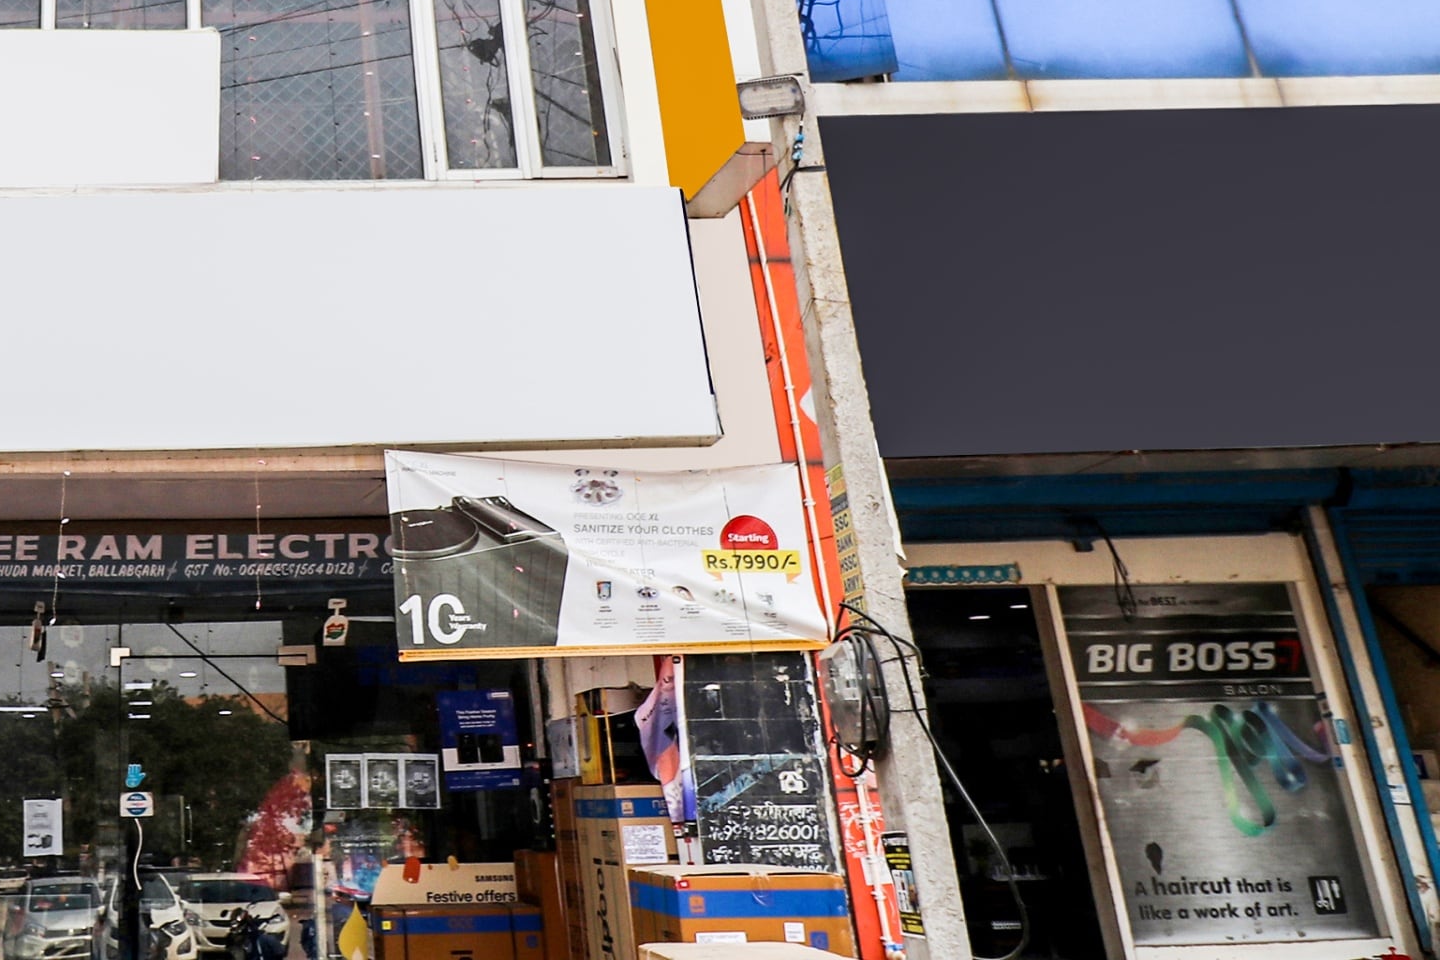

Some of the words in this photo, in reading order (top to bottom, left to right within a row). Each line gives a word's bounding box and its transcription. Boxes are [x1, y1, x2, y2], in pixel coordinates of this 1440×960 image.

[573, 524, 624, 534] SANITIZE
[627, 525, 659, 535] YOUR
[661, 525, 714, 536] CLOTHES
[727, 532, 770, 545] Starting
[57, 535, 163, 561] RAM
[32, 564, 86, 580] MARKET,
[88, 563, 165, 578] BALLABGARH
[184, 563, 209, 577] GST
[448, 613, 471, 622] Years
[1086, 643, 1153, 674] BIG
[1223, 684, 1282, 696] SALON
[475, 874, 514, 883] SAMSUNG
[1135, 881, 1148, 897] A
[1151, 876, 1232, 897] haircut
[1237, 878, 1272, 894] that
[1277, 877, 1293, 893] is
[426, 891, 474, 903] Festive
[476, 889, 517, 903] offers
[1139, 904, 1172, 921] like
[1178, 907, 1190, 919] a
[1193, 903, 1240, 919] work
[1244, 901, 1261, 918] of
[1267, 903, 1299, 917] art.
